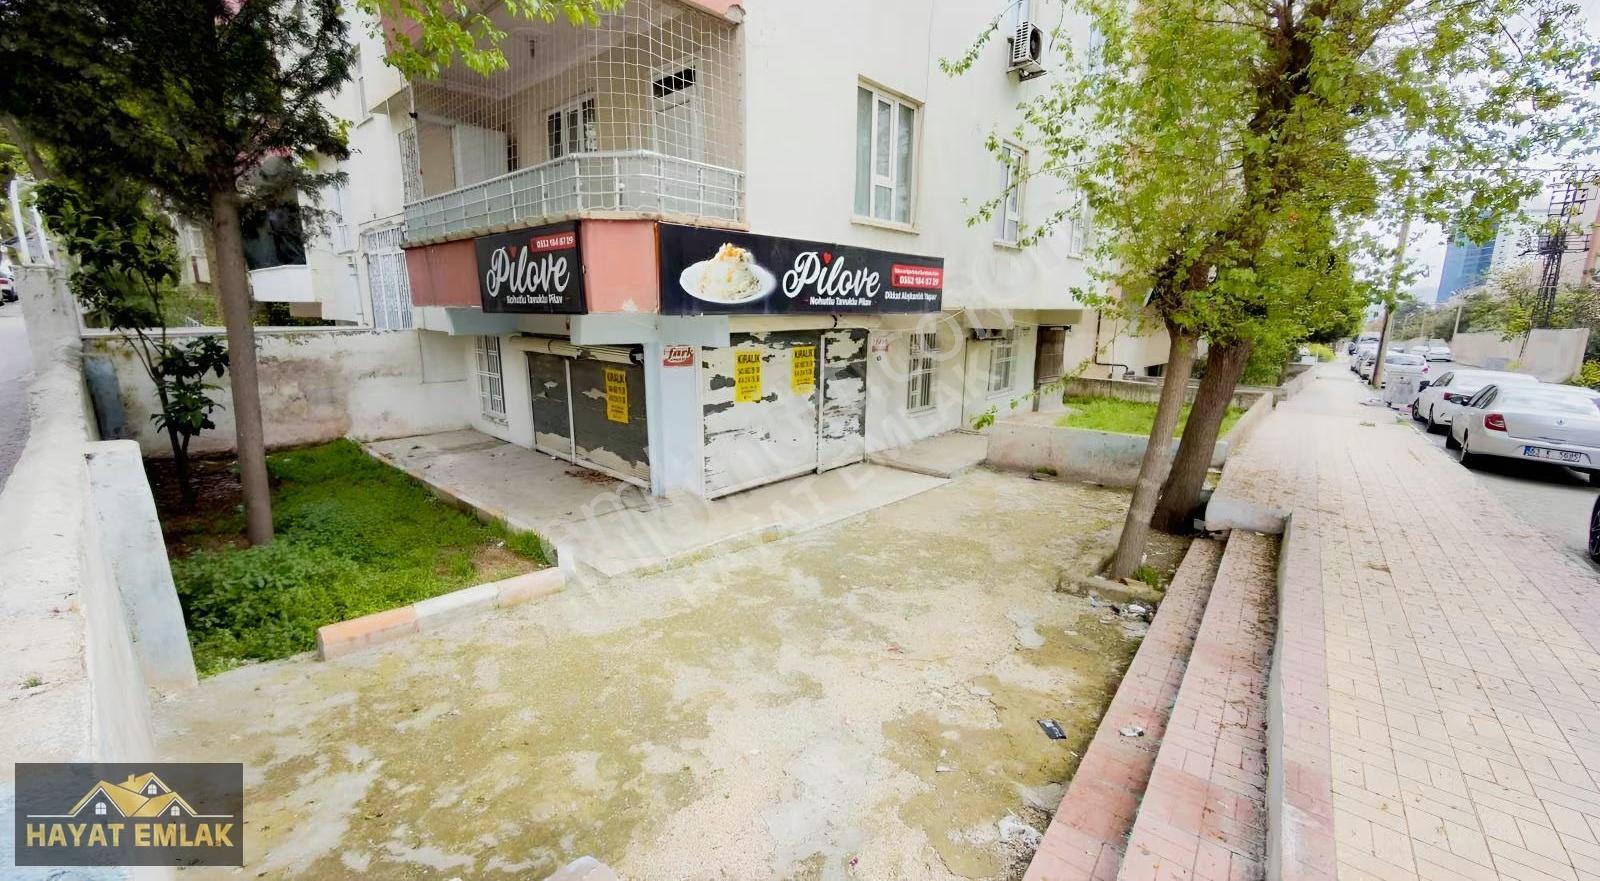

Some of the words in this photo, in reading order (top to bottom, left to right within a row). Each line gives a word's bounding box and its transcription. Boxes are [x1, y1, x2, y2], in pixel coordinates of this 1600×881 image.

[486, 245, 570, 298] Pilove
[782, 249, 880, 298] Pilove
[548, 293, 563, 304] Pilav
[809, 296, 835, 306] Nohutlu
[835, 297, 857, 306] Tavuklu
[737, 354, 761, 364] KIRALIK
